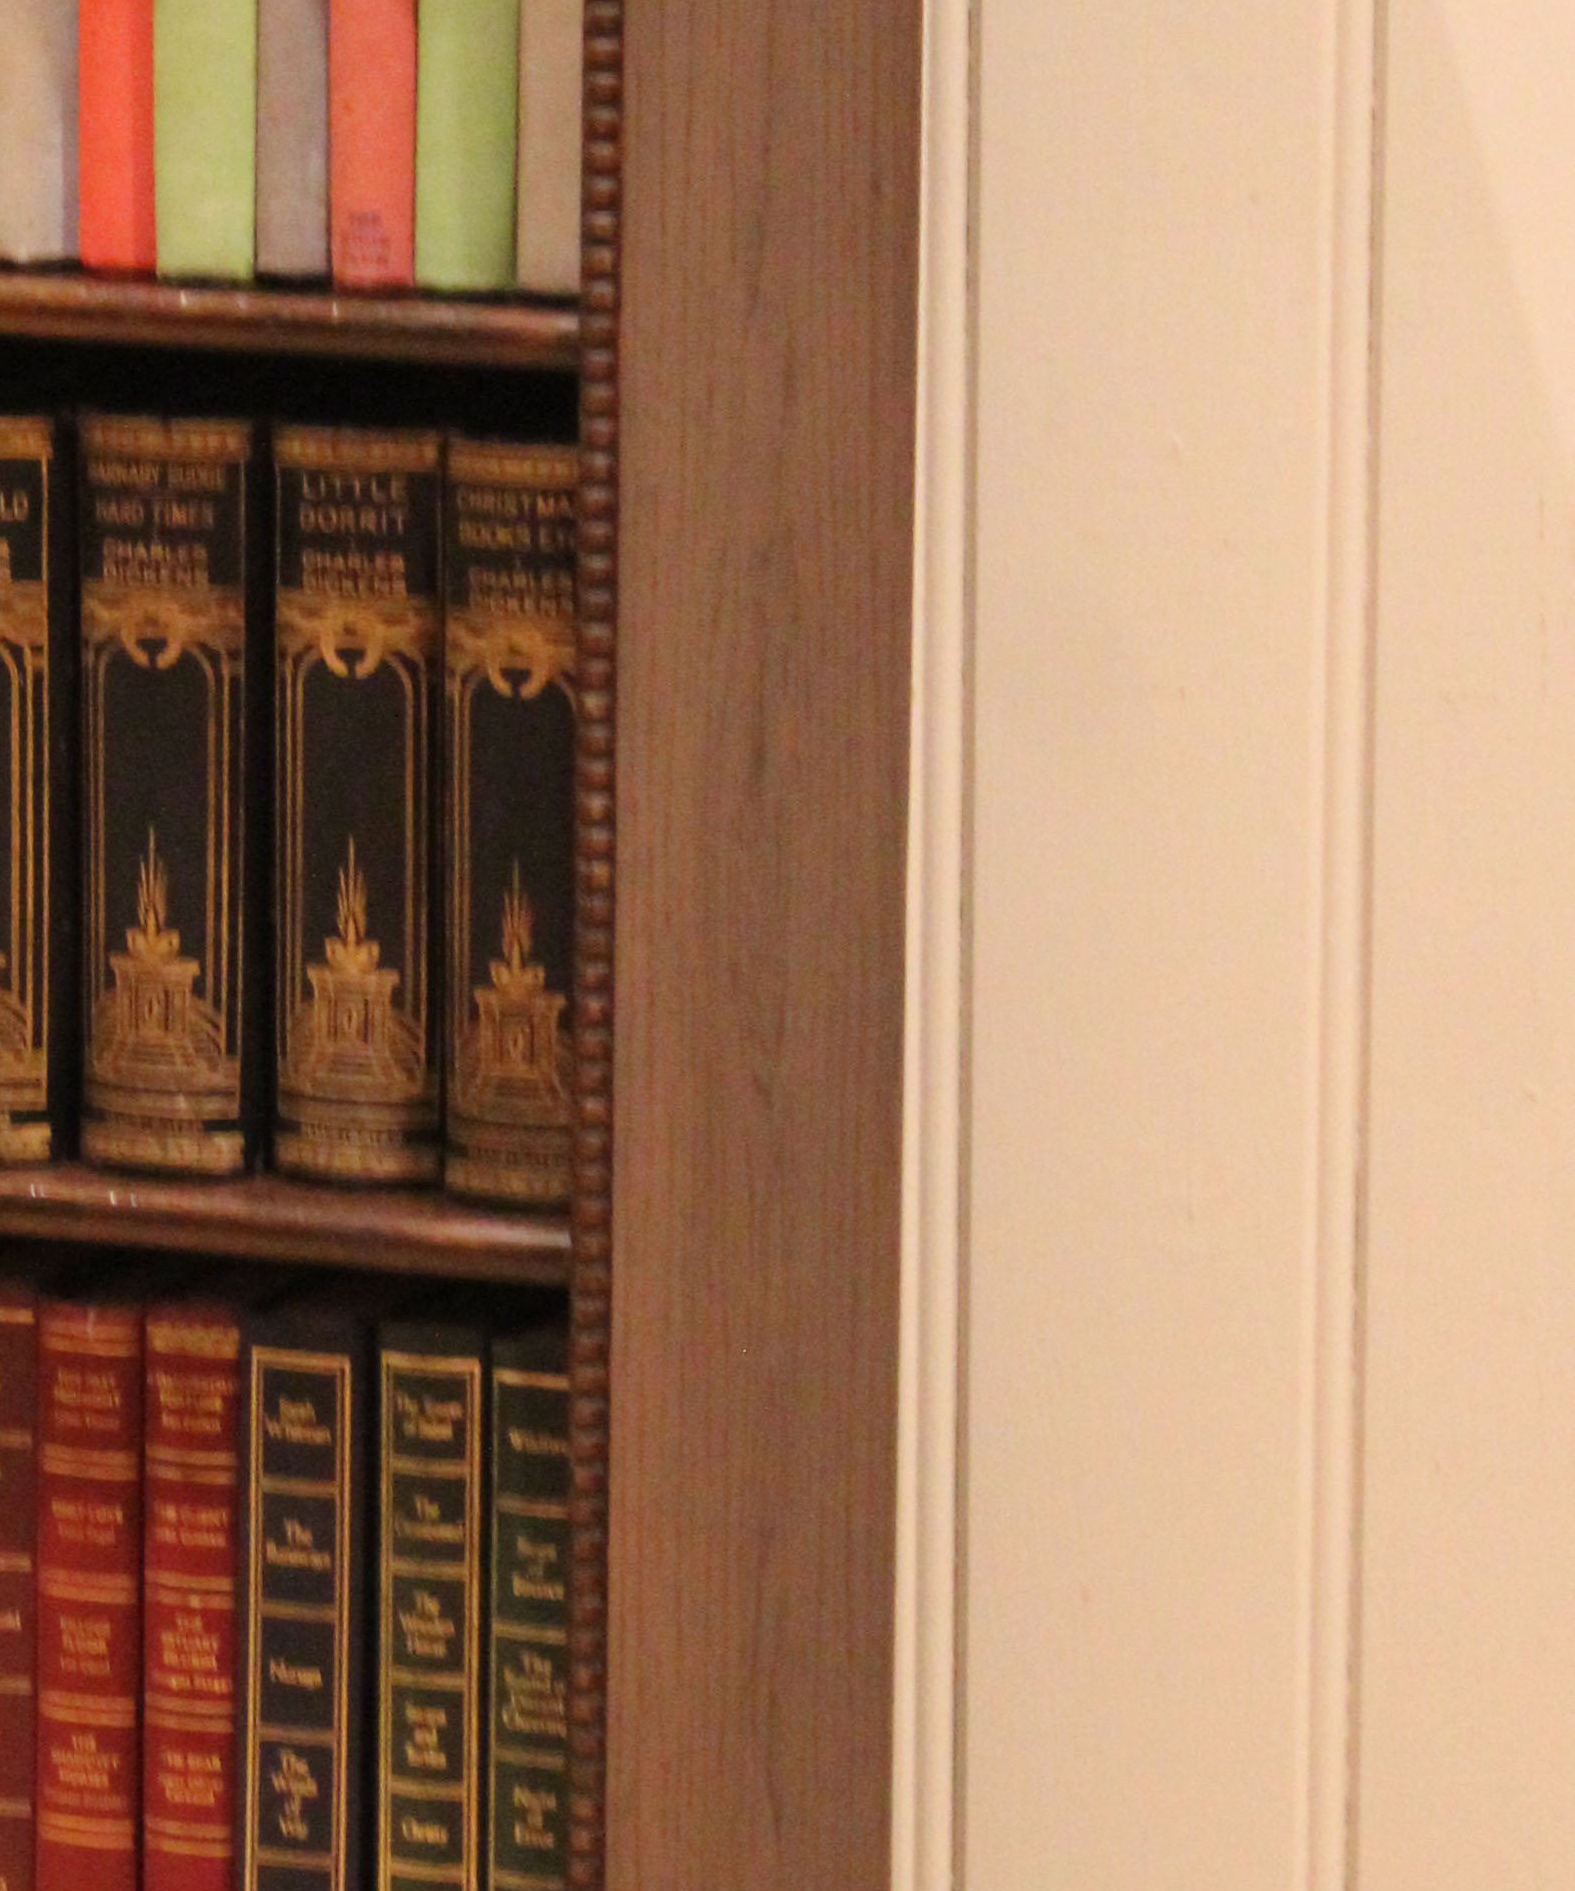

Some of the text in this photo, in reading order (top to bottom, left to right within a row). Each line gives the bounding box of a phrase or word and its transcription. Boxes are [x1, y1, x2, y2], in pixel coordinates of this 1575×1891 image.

[301, 471, 408, 502] LITTLE
[298, 503, 407, 535] DORRIT
[102, 536, 208, 562] CHARLES
[301, 548, 406, 572] CHARLES
[102, 561, 210, 588] DICKENS
[302, 571, 408, 597] DICKENS
